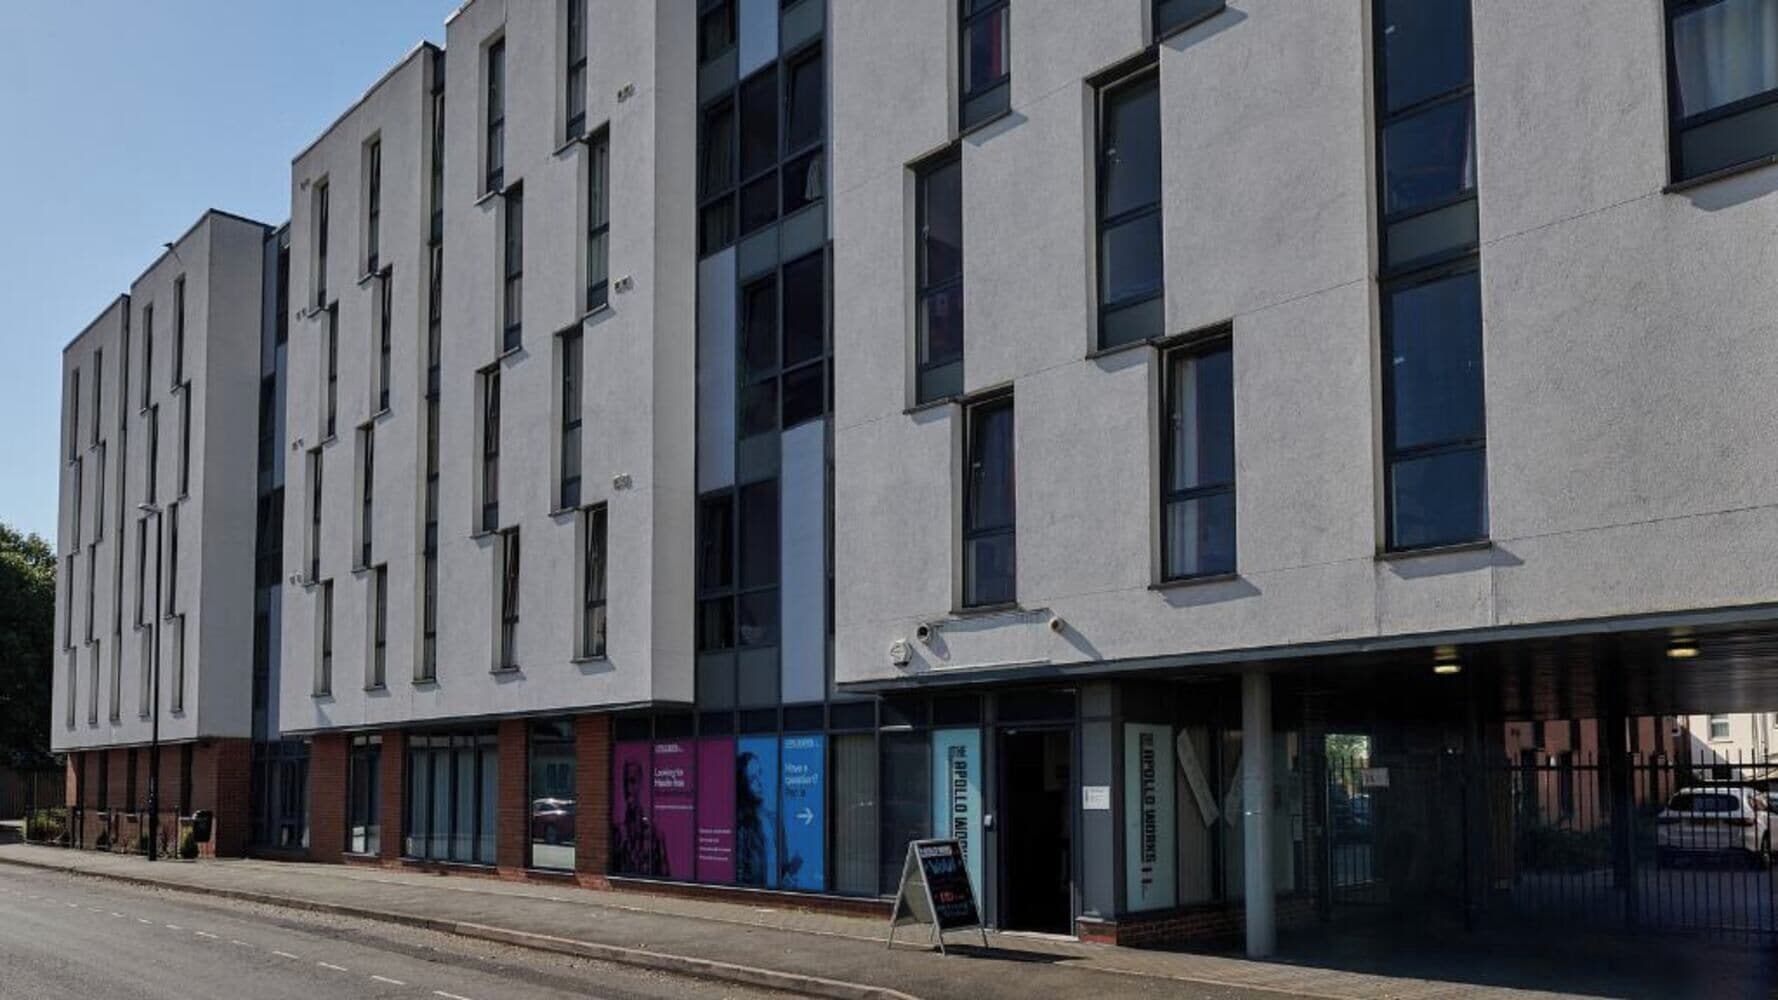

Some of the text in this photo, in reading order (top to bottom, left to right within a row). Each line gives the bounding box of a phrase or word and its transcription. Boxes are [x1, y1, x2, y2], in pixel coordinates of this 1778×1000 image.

[654, 767, 676, 779] Looking
[784, 762, 803, 773] Have
[954, 761, 968, 813] APOLLO
[1143, 749, 1156, 804] APOLLO
[1143, 809, 1157, 862] WORKS
